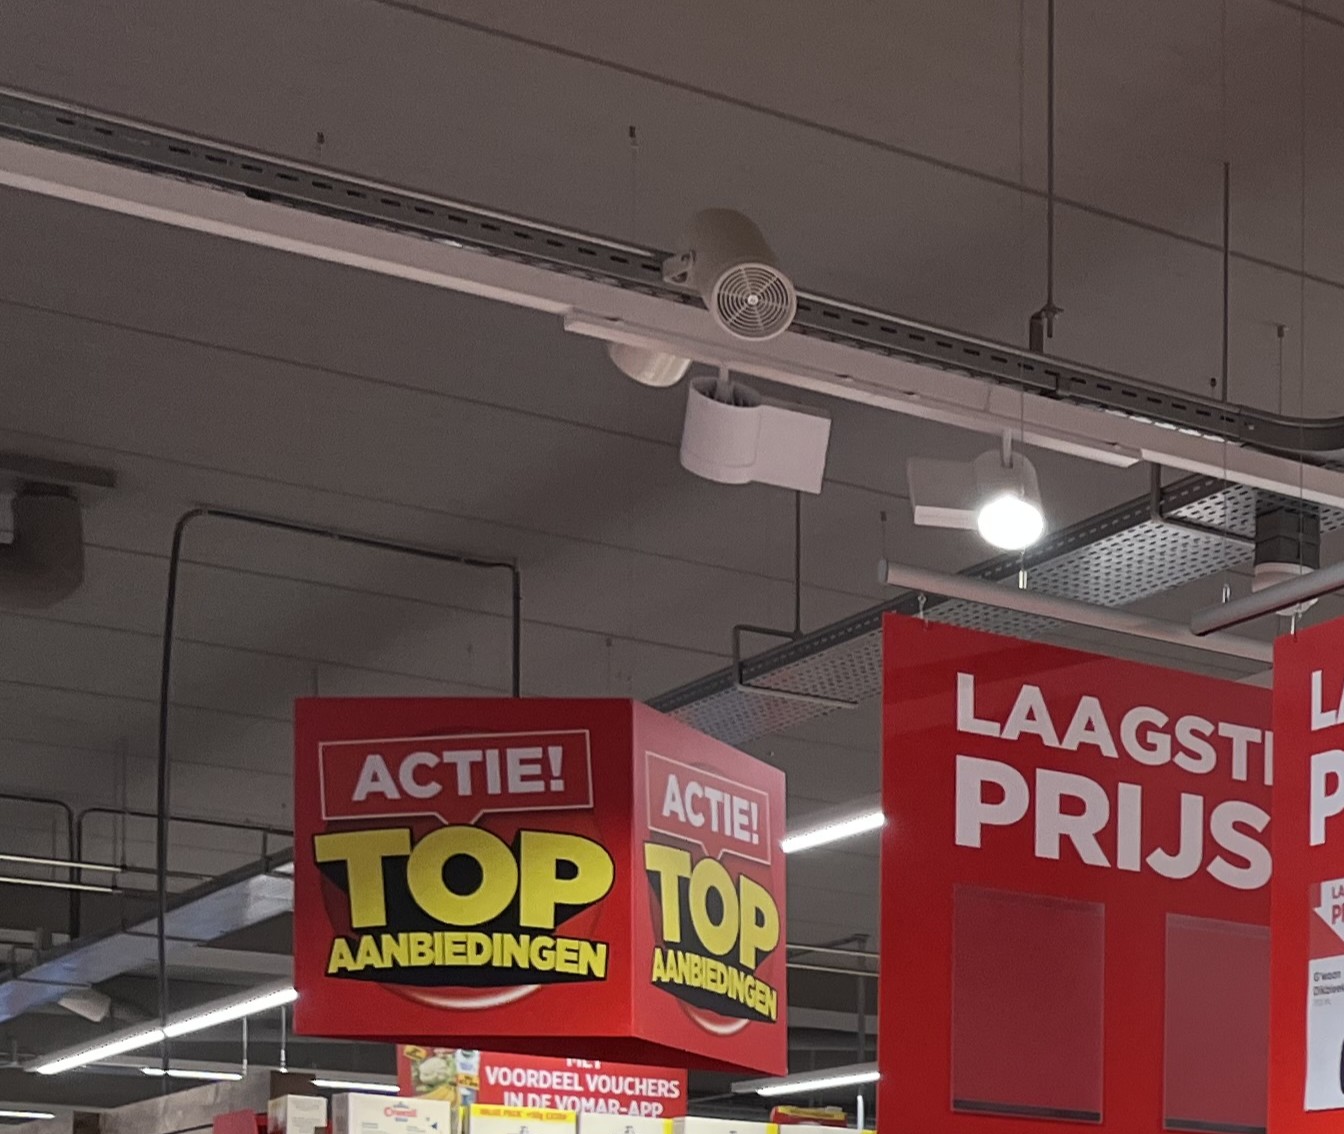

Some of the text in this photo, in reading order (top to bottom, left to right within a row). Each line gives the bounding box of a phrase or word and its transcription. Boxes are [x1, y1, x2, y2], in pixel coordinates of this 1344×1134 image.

[956, 671, 1273, 787] LAAGST
[351, 745, 565, 801] ACTIE!
[661, 773, 759, 845] ACTIE!
[954, 753, 1272, 891] PRIJS
[313, 825, 615, 929] TOP
[644, 842, 780, 969] TOP
[327, 932, 607, 978] AANBIEDINGEN
[651, 947, 777, 1021] AANBIEDINGEN
[485, 1066, 681, 1098] VOORDEEL VOUCHERS
[503, 1091, 664, 1118] IN DE VOMAR-APP
